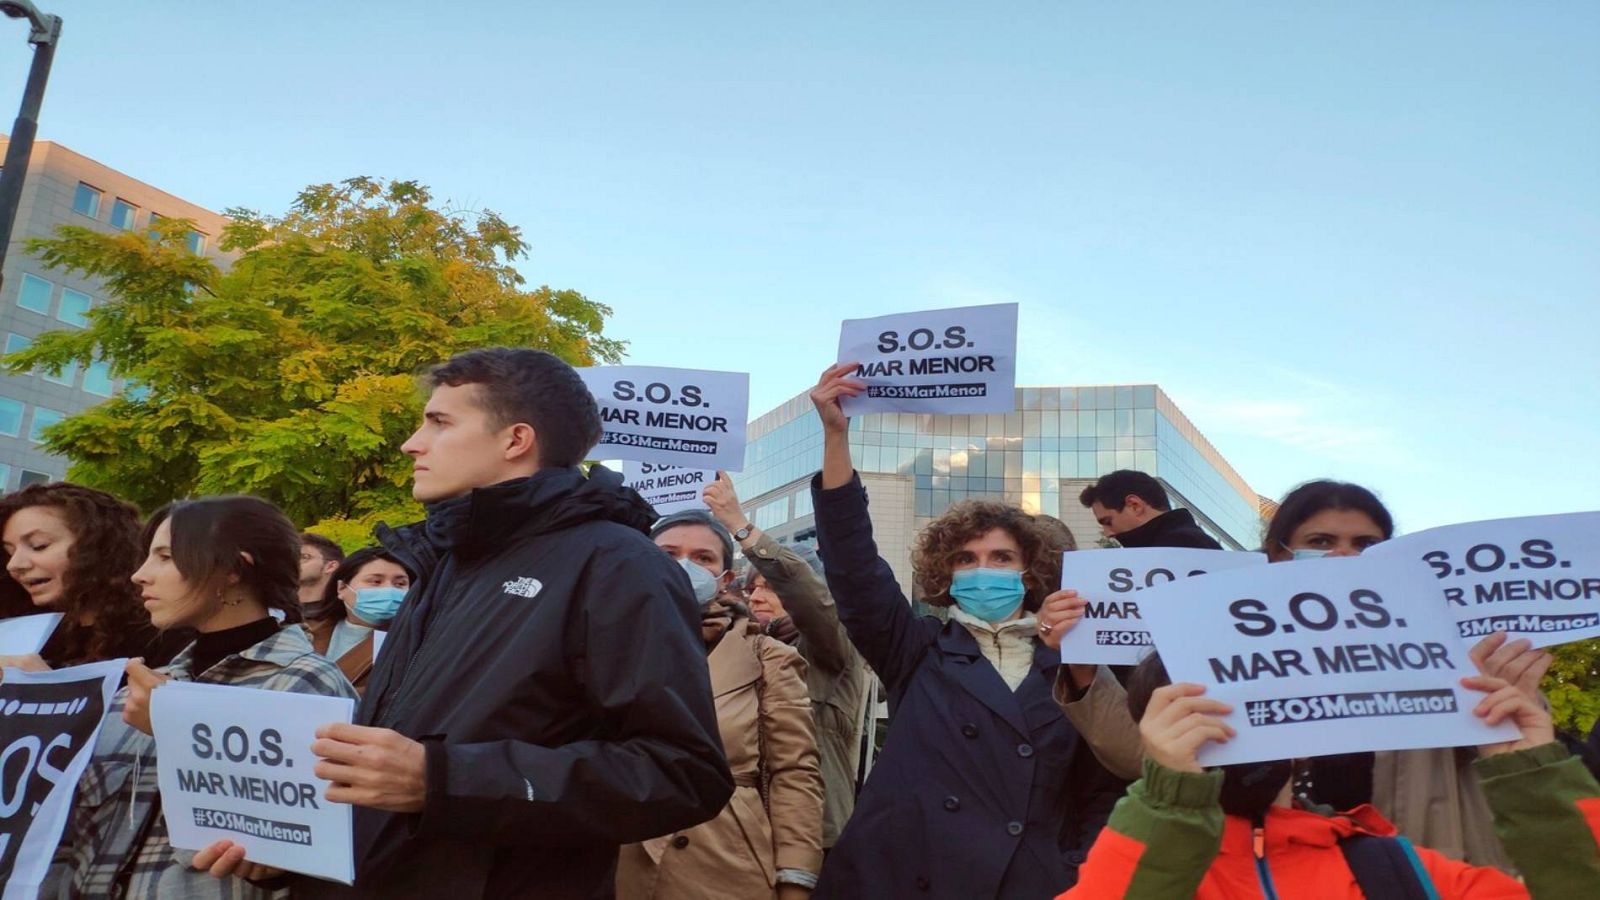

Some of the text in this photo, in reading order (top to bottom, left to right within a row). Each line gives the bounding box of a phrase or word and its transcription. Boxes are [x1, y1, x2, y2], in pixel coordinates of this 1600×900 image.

[877, 326, 974, 353] S.O.S.
[856, 355, 996, 377] MAR MENOR
[613, 380, 710, 408] S.O.S.
[868, 384, 985, 398] #SOSMarMenor
[646, 411, 728, 433] MENOR
[600, 432, 716, 454] #SOSMarMenor
[657, 471, 704, 488] MENOR
[1422, 539, 1572, 579] S.O.S.
[1474, 578, 1600, 604] MENOR
[1085, 602, 1142, 619] MAR
[1228, 588, 1408, 637] S.O.S.
[1208, 642, 1456, 684] MAR MENOR
[1248, 692, 1455, 725] #SOSMarMenor
[192, 723, 293, 767] S.O.S.
[176, 768, 320, 809] MAR MENOR
[194, 809, 311, 844] #SOSMarMenor
